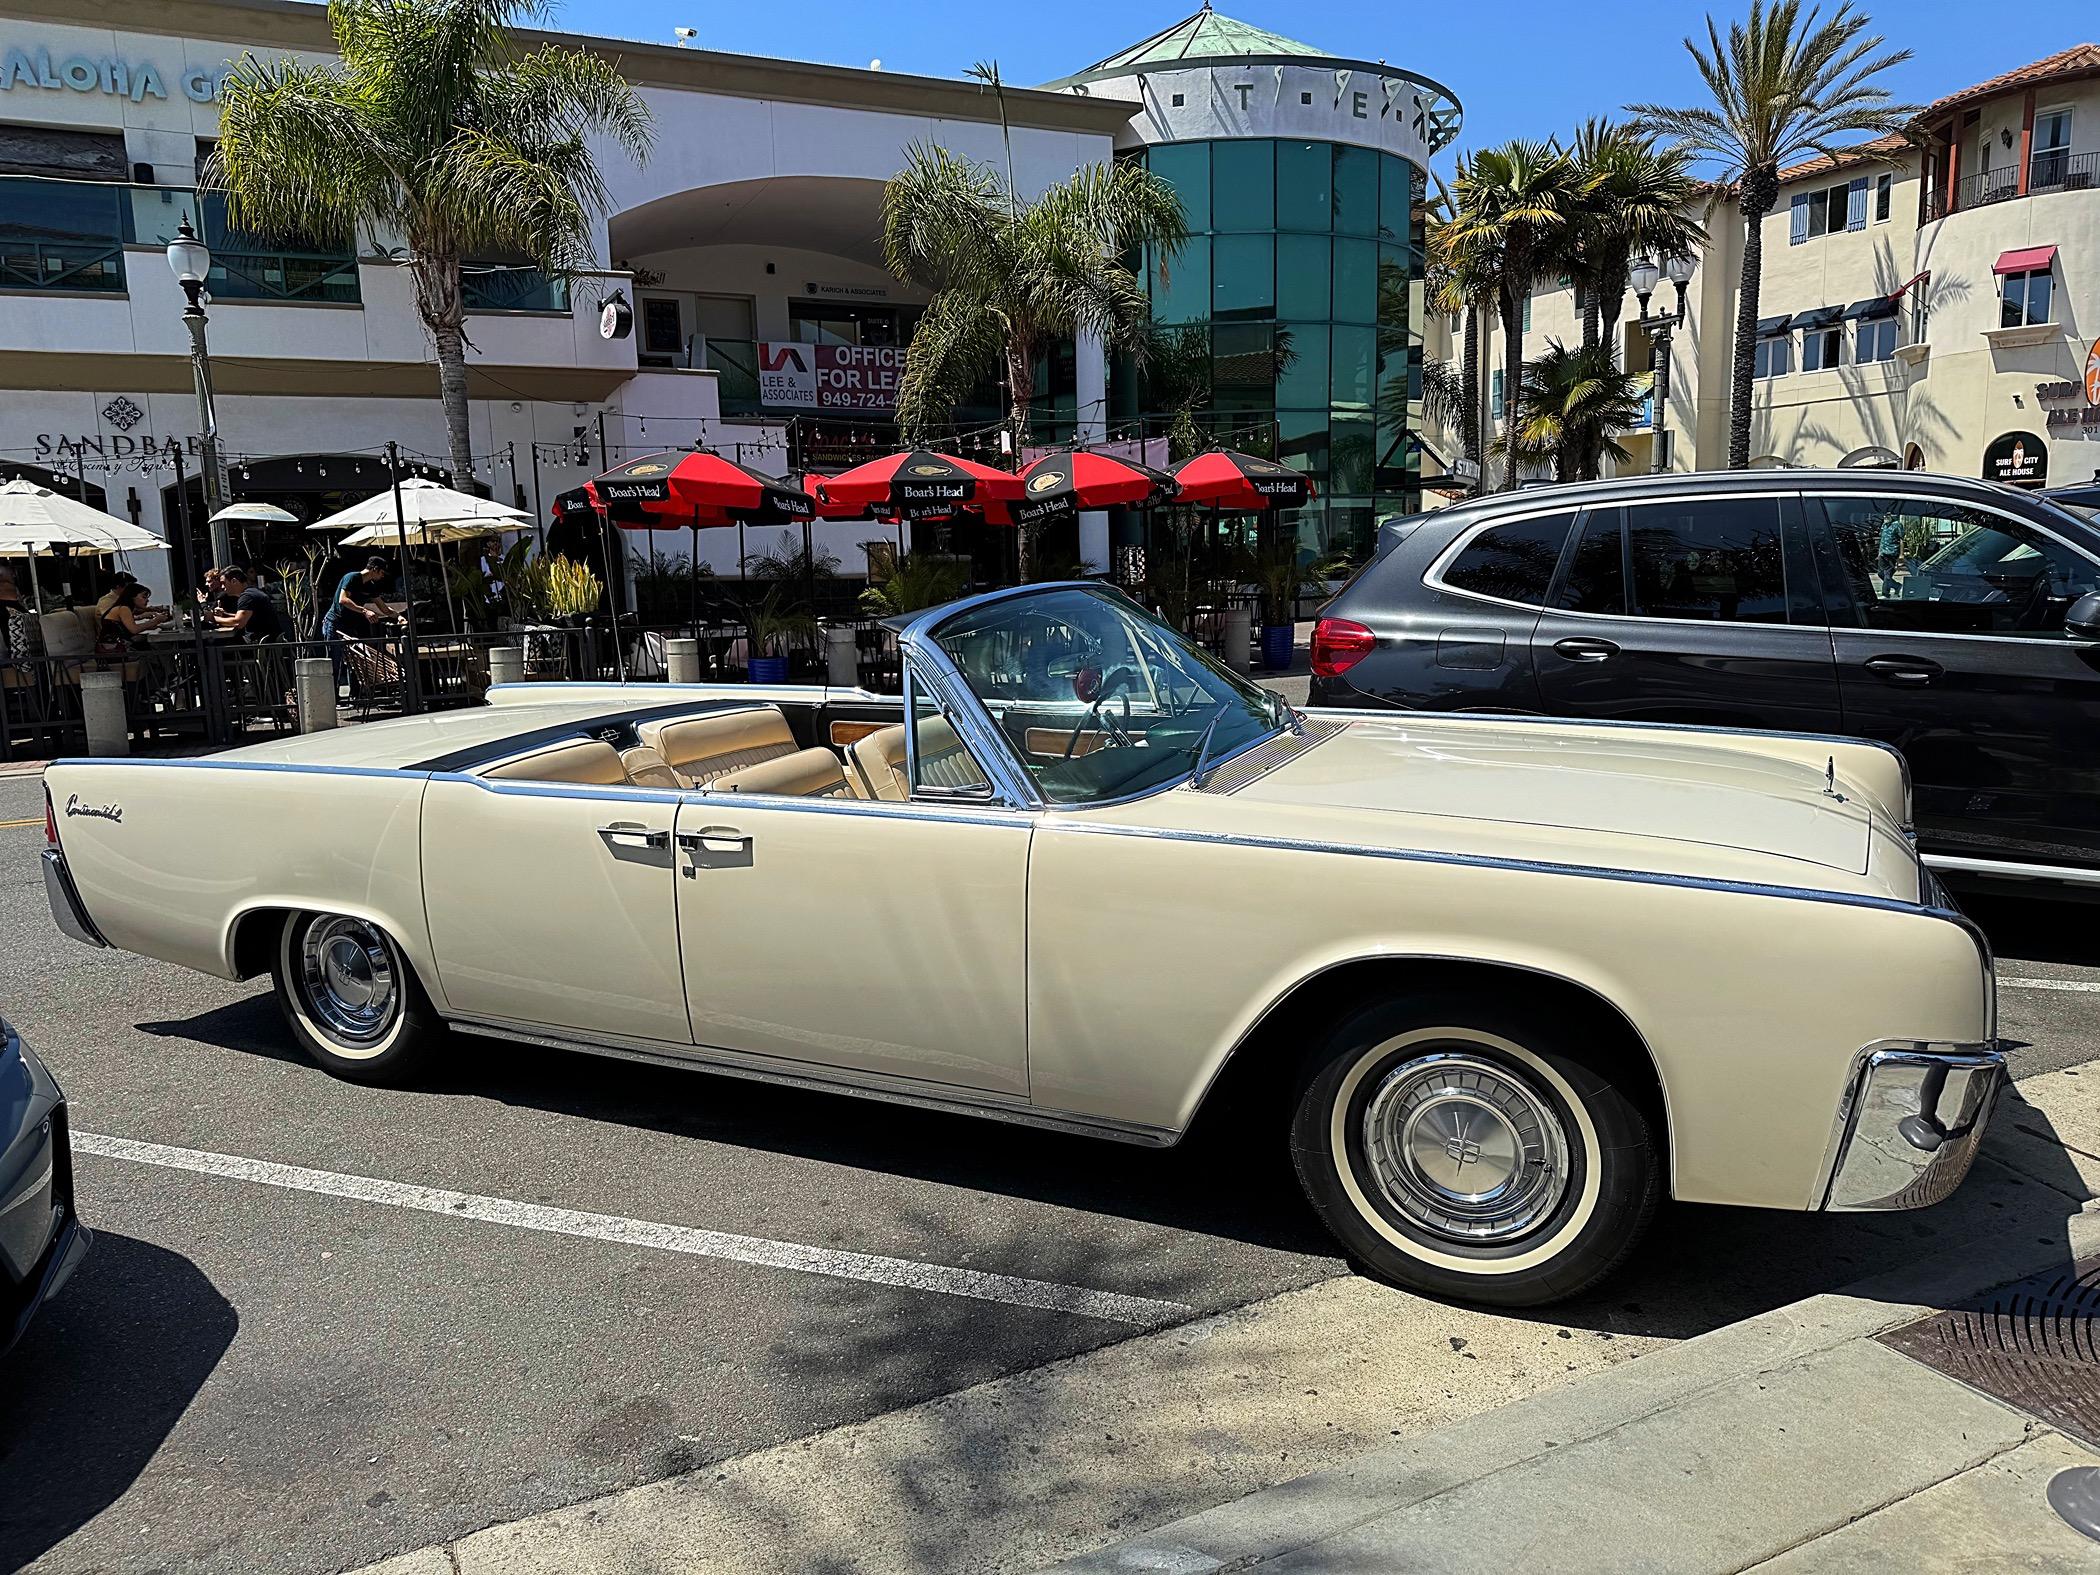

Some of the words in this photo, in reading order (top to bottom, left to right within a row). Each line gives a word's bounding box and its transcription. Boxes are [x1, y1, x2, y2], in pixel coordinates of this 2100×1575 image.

[0, 45, 168, 103] ALOHA
[835, 346, 907, 368] OFFICE
[762, 376, 784, 387] LEE
[788, 376, 797, 388] &
[816, 368, 862, 389] FOR
[867, 371, 905, 391] LEA
[762, 389, 814, 402] ASSOCIATES
[2036, 381, 2081, 400] SURF
[822, 391, 898, 408] 949-724-4
[1995, 458, 2013, 466] SURF
[2023, 456, 2039, 465] CITY
[1999, 468, 2012, 477] ALE
[2012, 467, 2034, 476] HOUSE
[607, 486, 637, 498] Boar's
[638, 485, 661, 497] Head
[905, 486, 934, 498] Boar's
[936, 485, 964, 497] Head
[1276, 482, 1297, 493] Head
[790, 499, 809, 514] Head
[932, 503, 952, 516] Head
[1019, 504, 1044, 521] Boar's
[1043, 498, 1069, 514] Head
